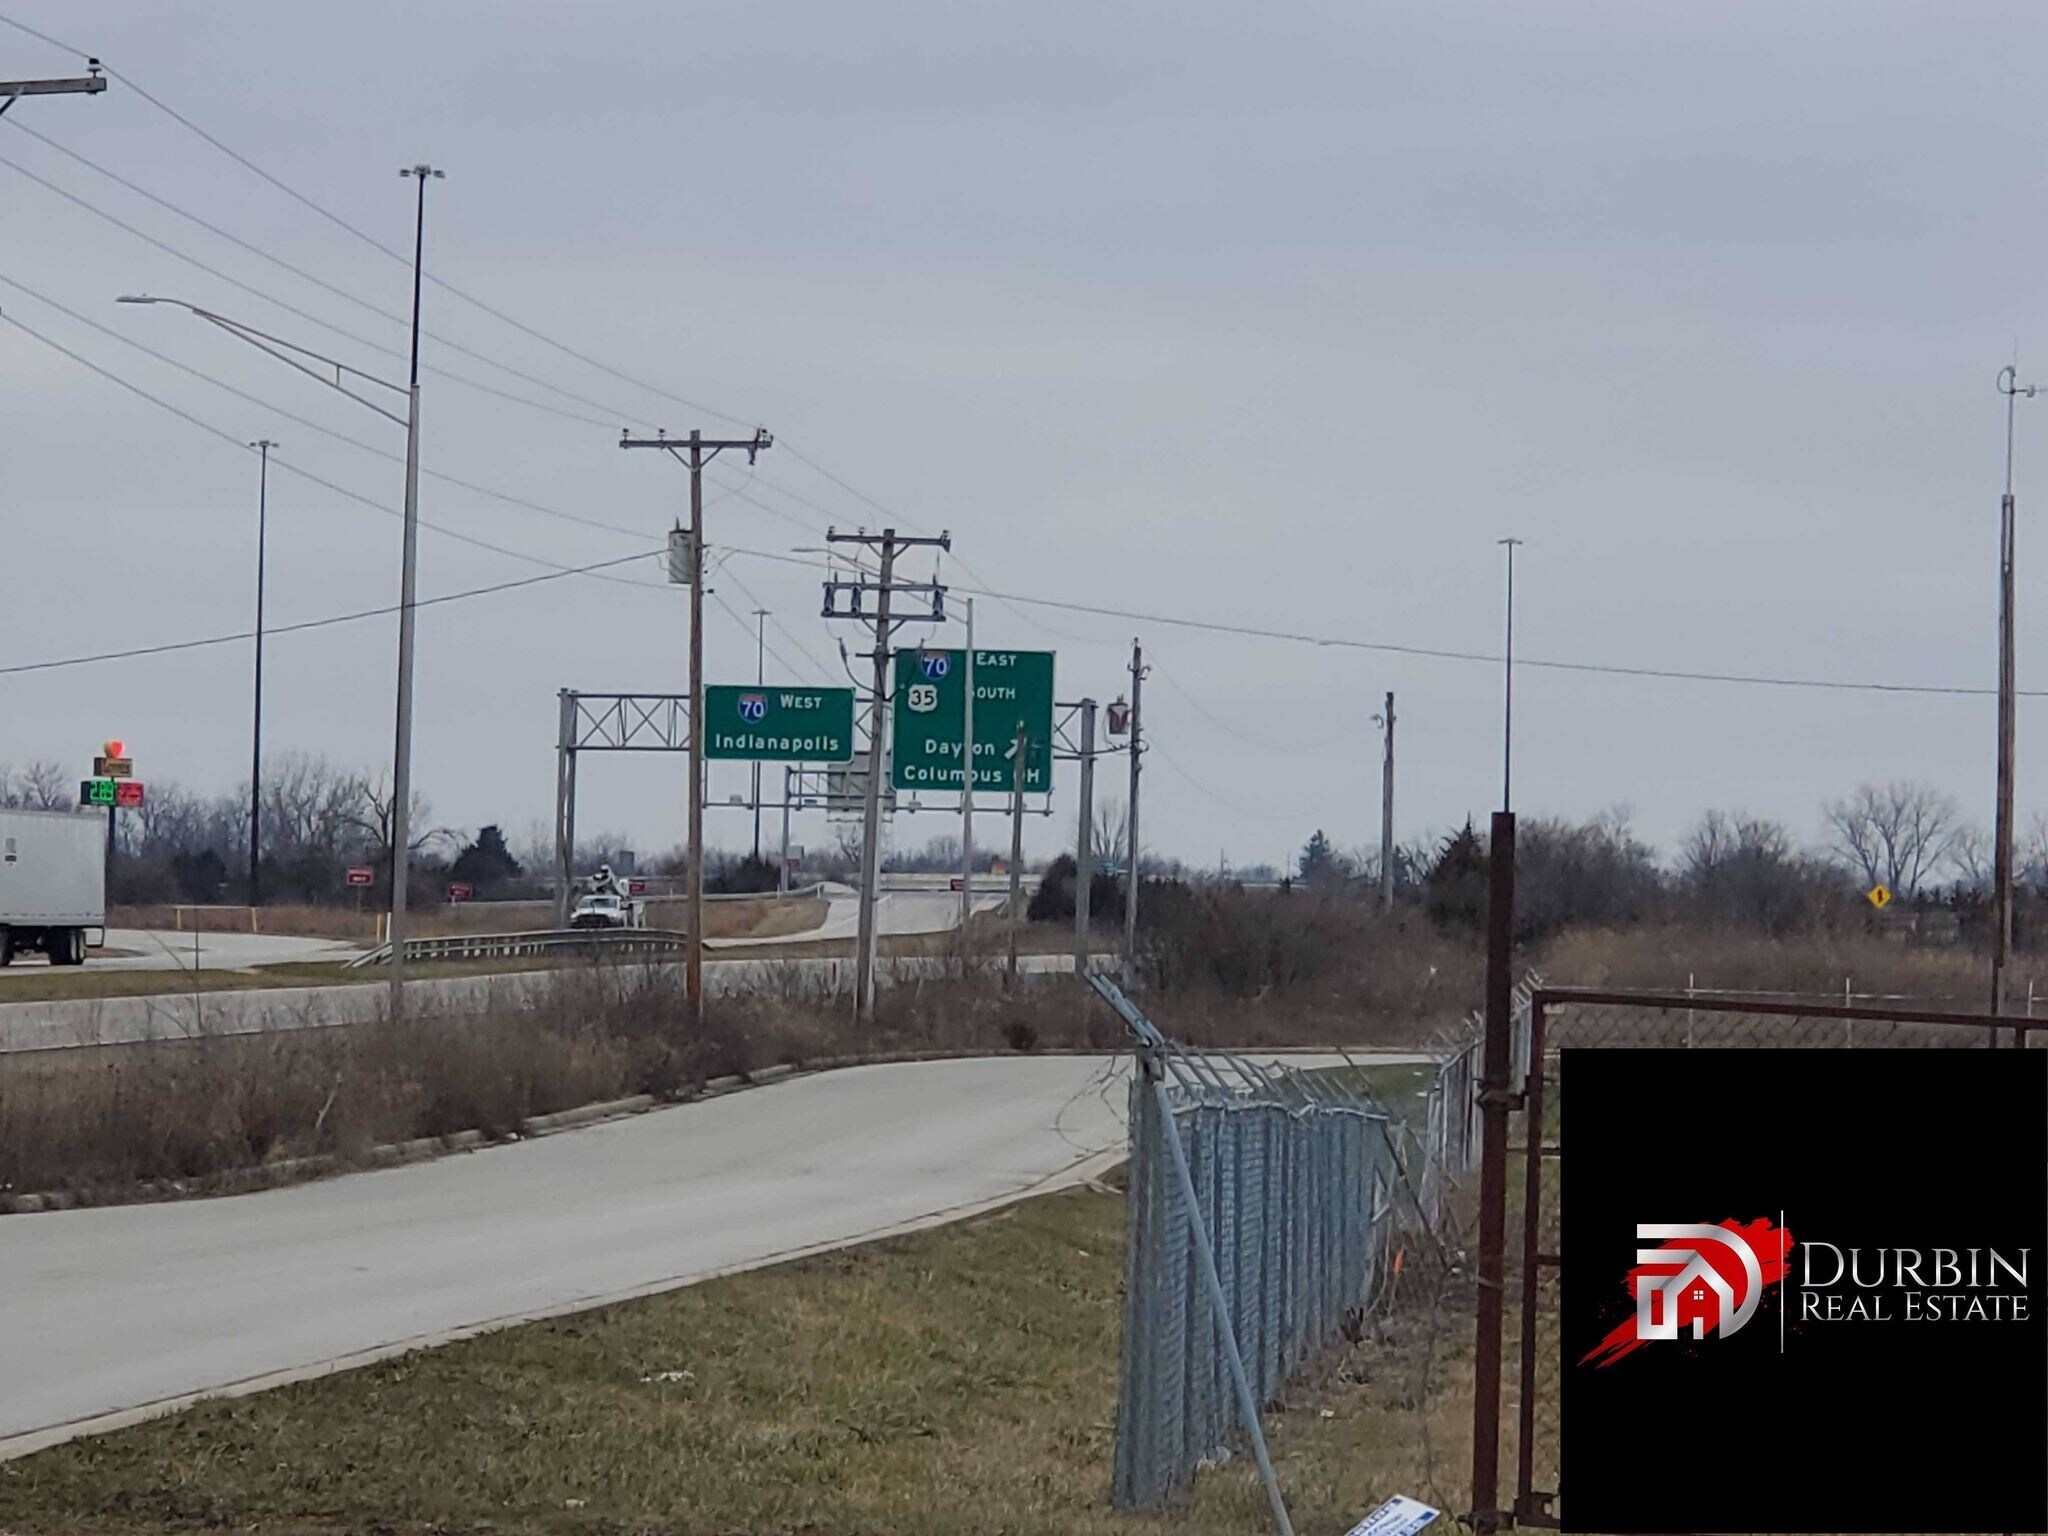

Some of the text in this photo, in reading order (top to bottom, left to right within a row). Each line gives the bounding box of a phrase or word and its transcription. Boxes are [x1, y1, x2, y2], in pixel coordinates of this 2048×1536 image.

[924, 652, 1017, 675] 70 EAST
[742, 693, 822, 717] 70 WEST
[911, 687, 1016, 706] 35 OUTH
[715, 734, 839, 753] Indianapolis
[925, 739, 995, 759] Dayon
